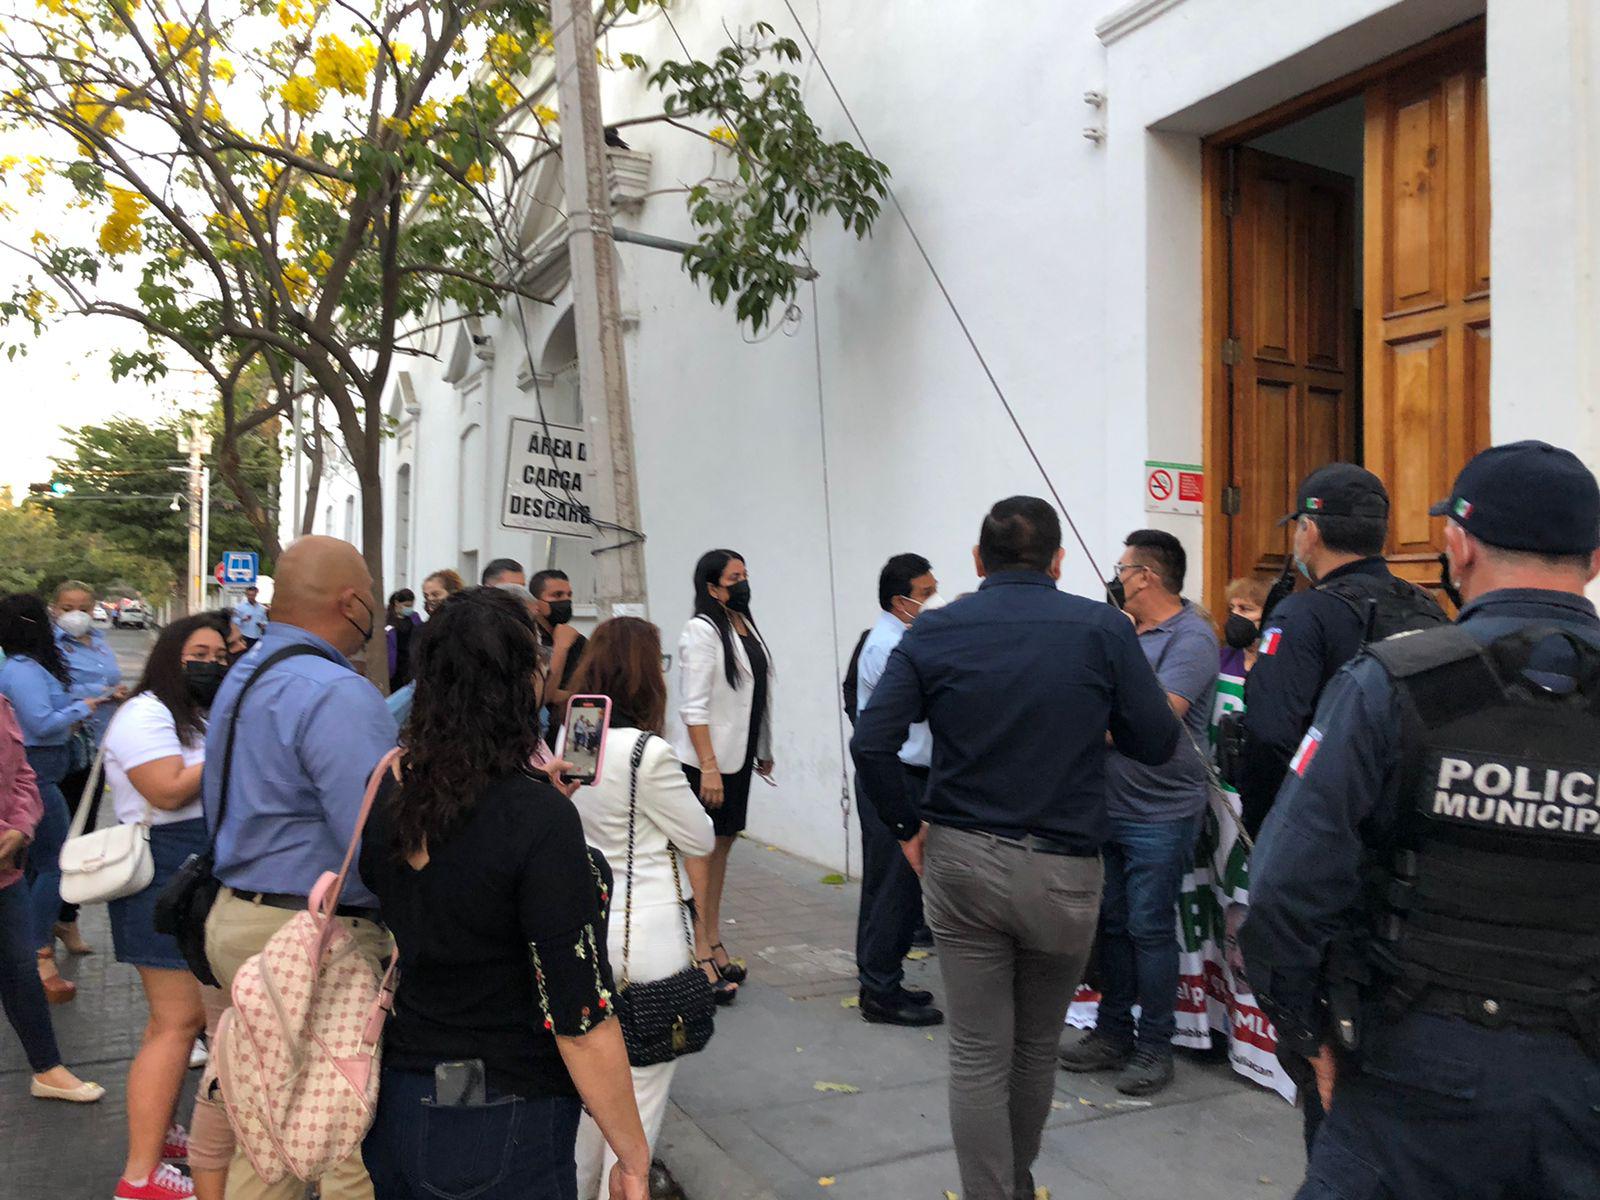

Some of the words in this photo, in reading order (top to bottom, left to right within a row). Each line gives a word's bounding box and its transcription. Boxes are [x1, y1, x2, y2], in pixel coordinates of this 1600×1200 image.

[577, 443, 587, 461] D
[523, 464, 582, 491] CARGA
[510, 495, 591, 524] DESCARG
